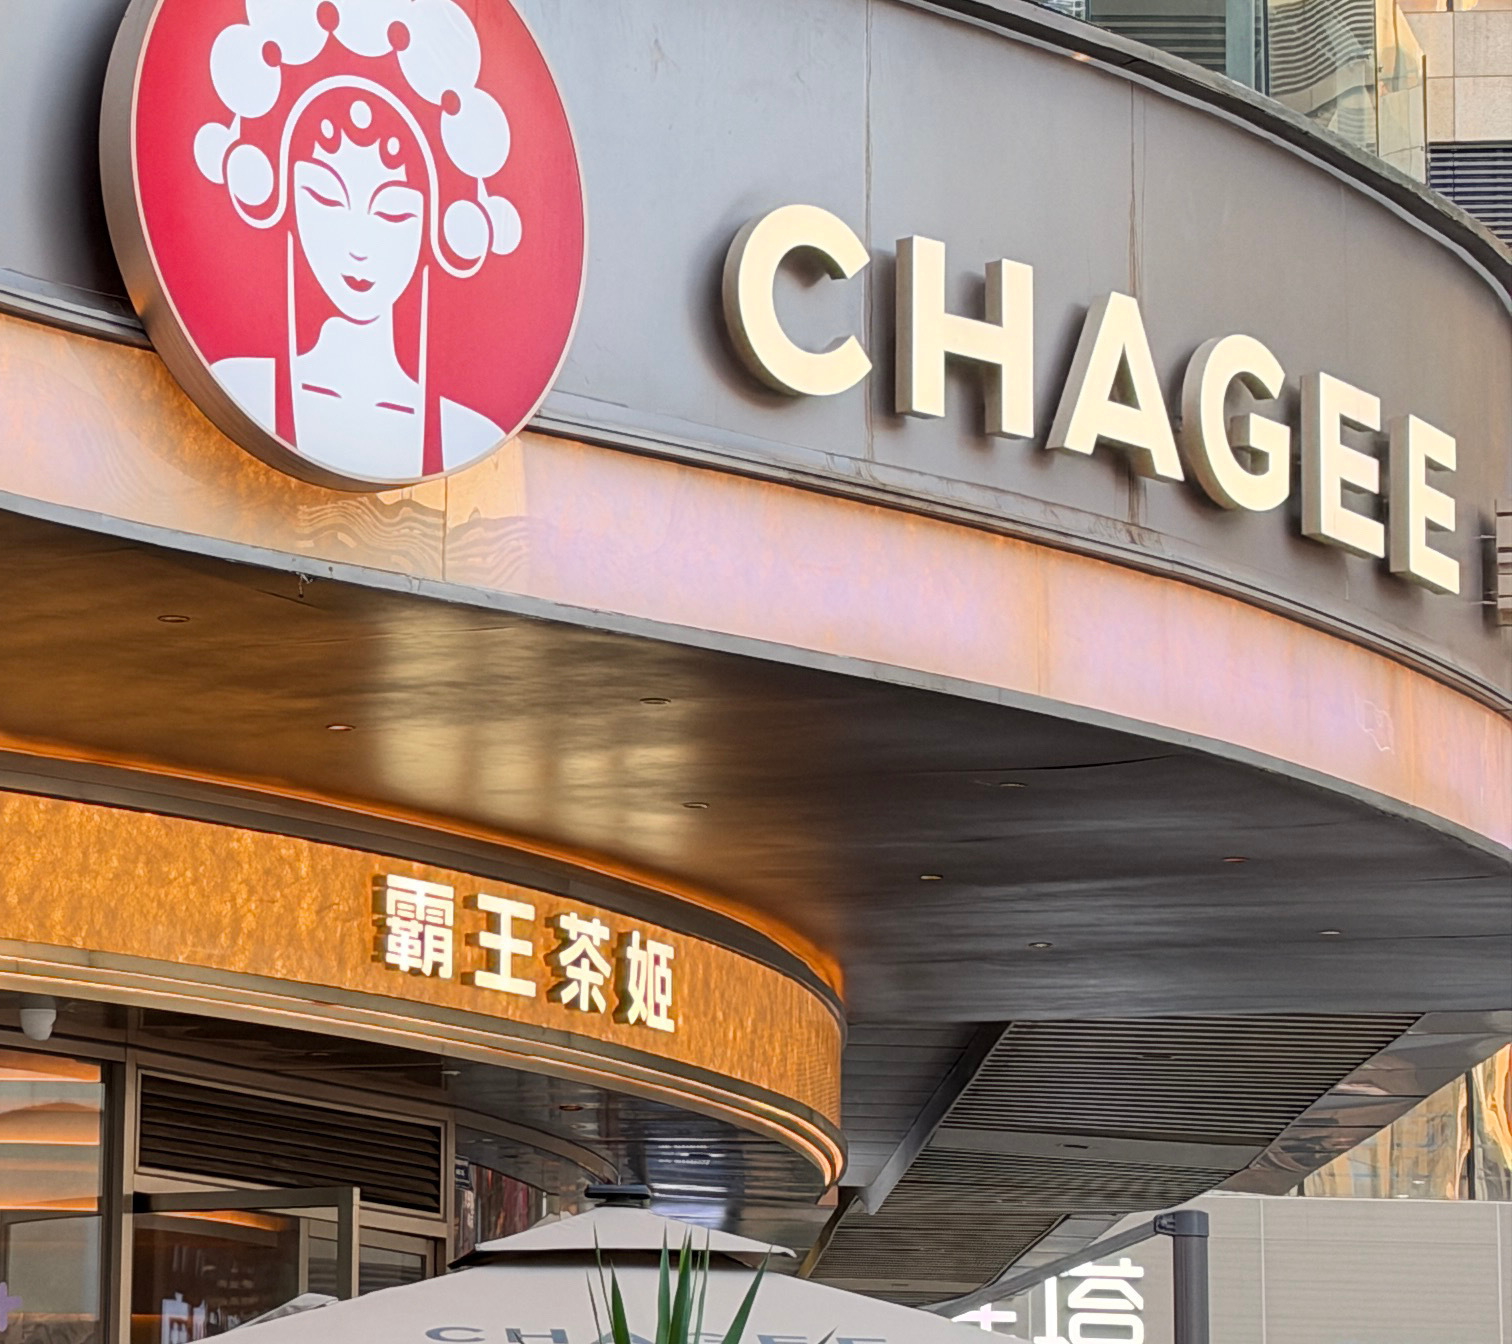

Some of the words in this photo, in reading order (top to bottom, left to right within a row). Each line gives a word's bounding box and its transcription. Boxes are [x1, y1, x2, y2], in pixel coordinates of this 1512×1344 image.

[724, 204, 1461, 595] CHAGEE
[381, 874, 675, 1033] 霸王茶姬
